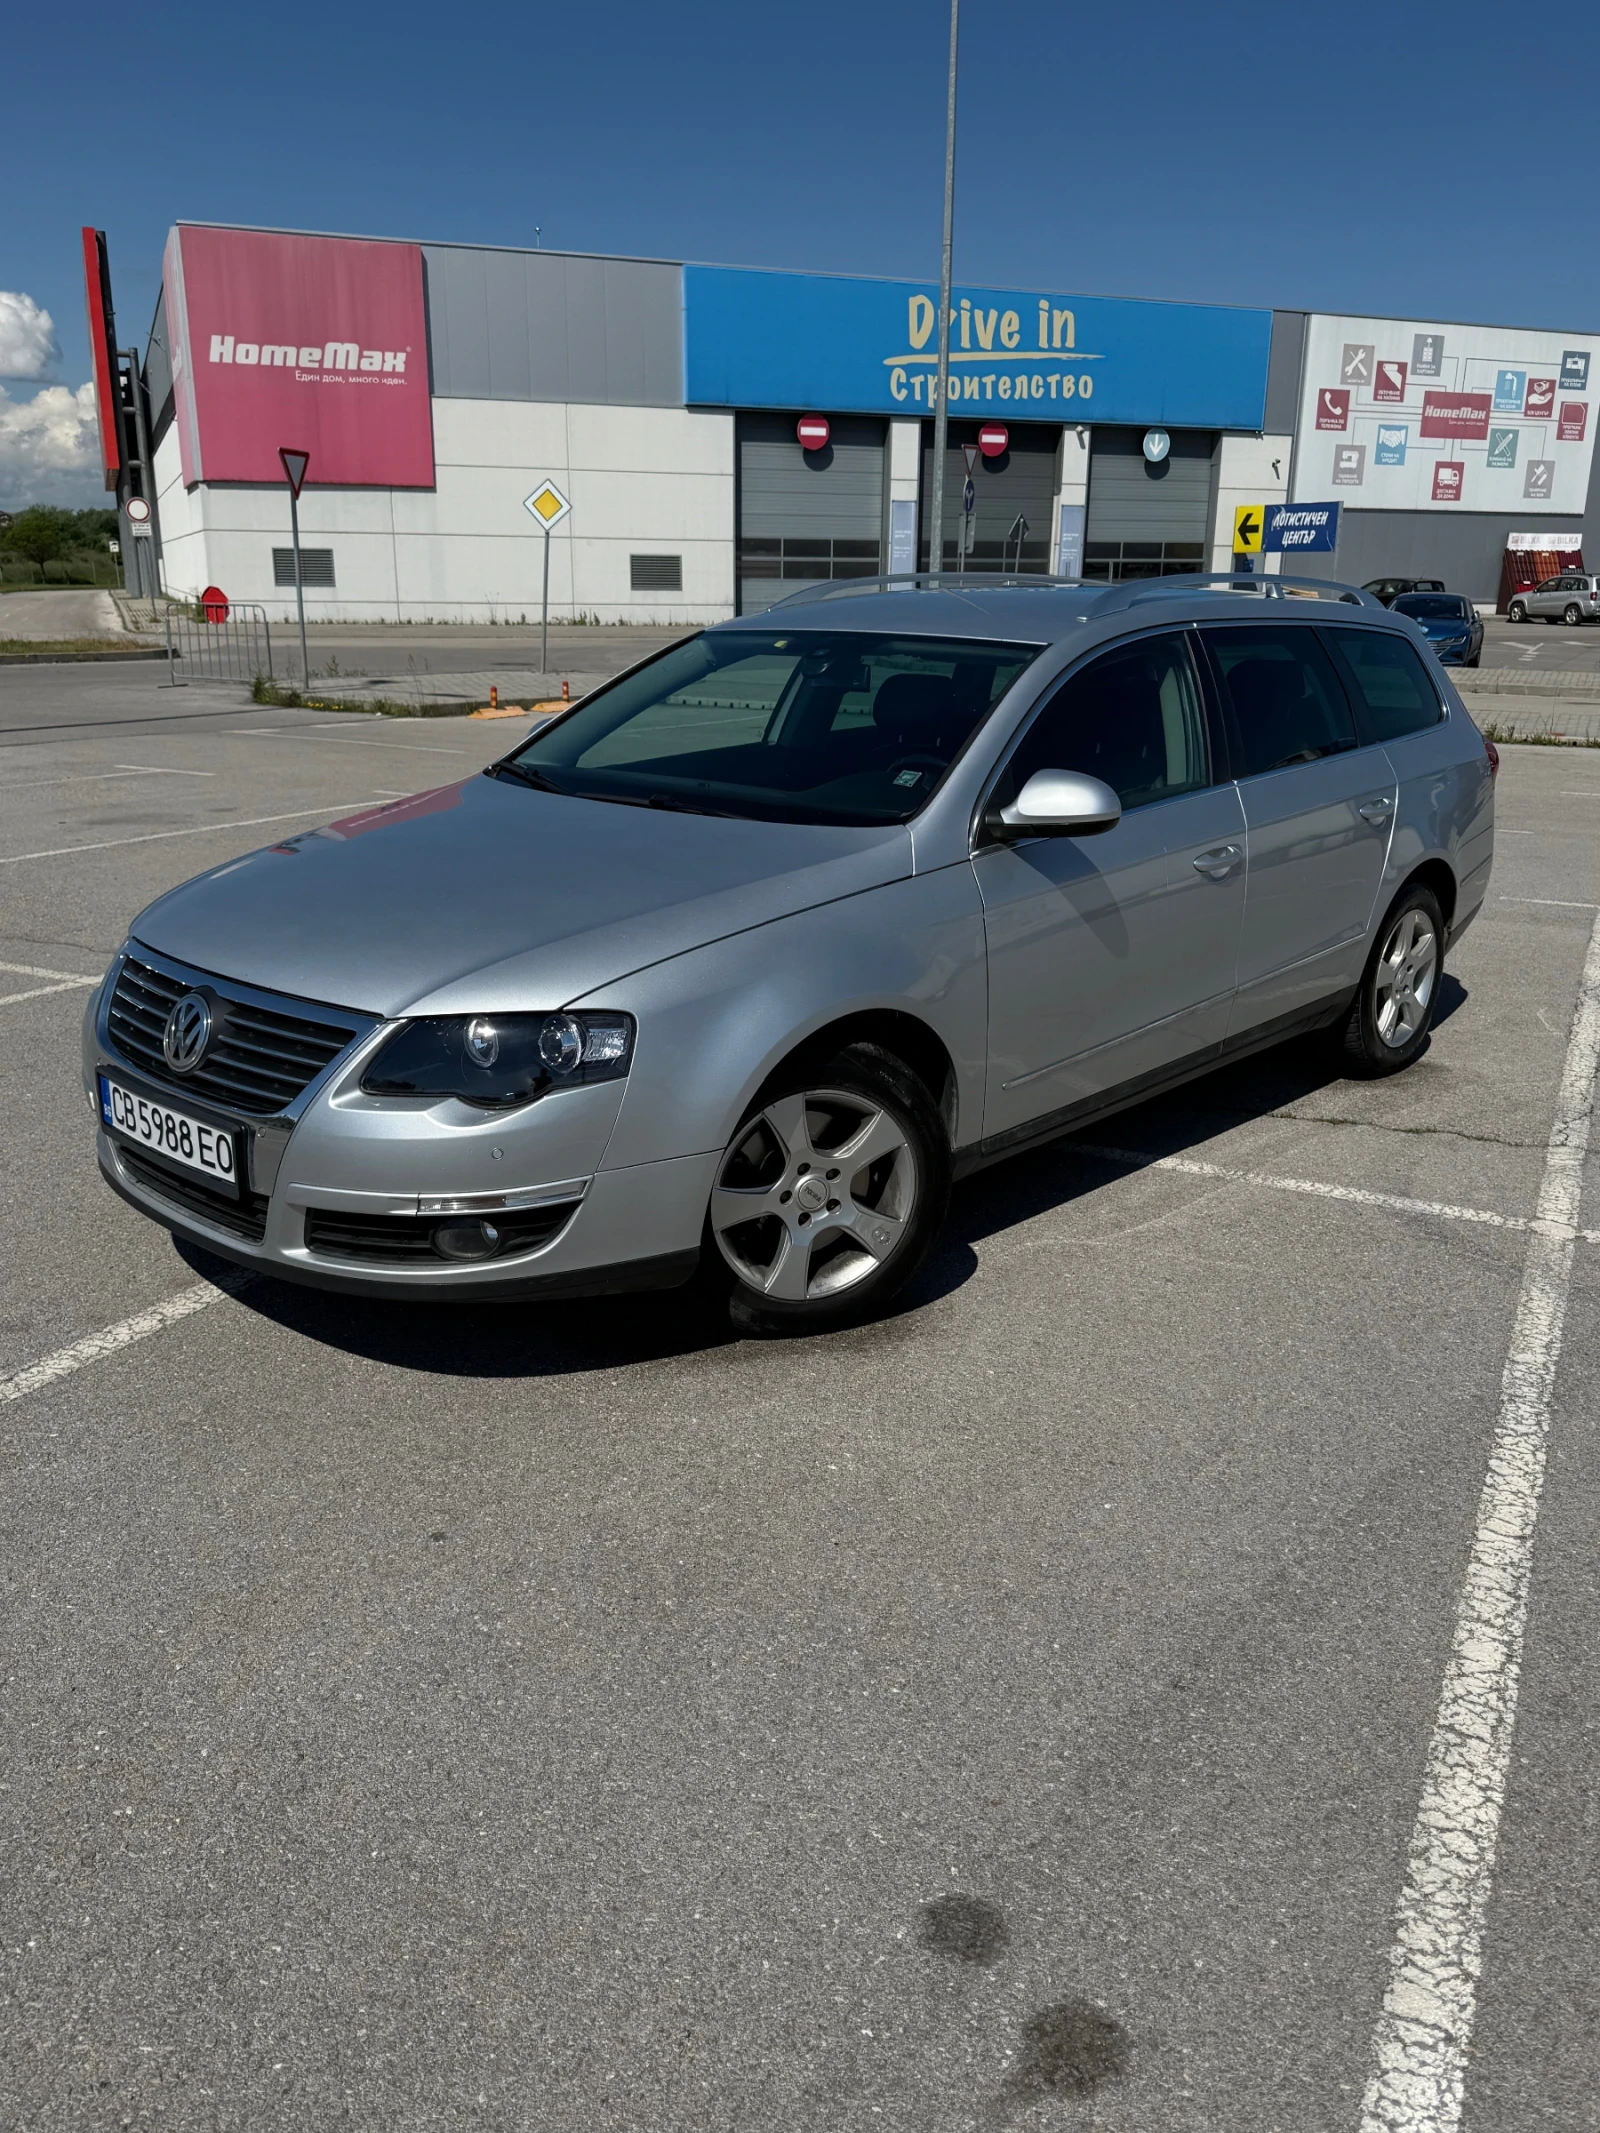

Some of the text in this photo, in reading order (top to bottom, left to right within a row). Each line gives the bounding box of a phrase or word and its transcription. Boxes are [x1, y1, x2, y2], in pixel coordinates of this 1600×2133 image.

[1038, 299, 1075, 349] in
[209, 334, 406, 372] HomeMax
[295, 370, 320, 382] Един
[322, 374, 345, 383] дом,
[348, 376, 379, 384] много
[890, 367, 1093, 408] Строителство
[1424, 405, 1486, 420] HomeMax
[1273, 511, 1329, 527] ЛОГИСТИЧЕН
[1281, 529, 1316, 548] ЦЕНТЪР
